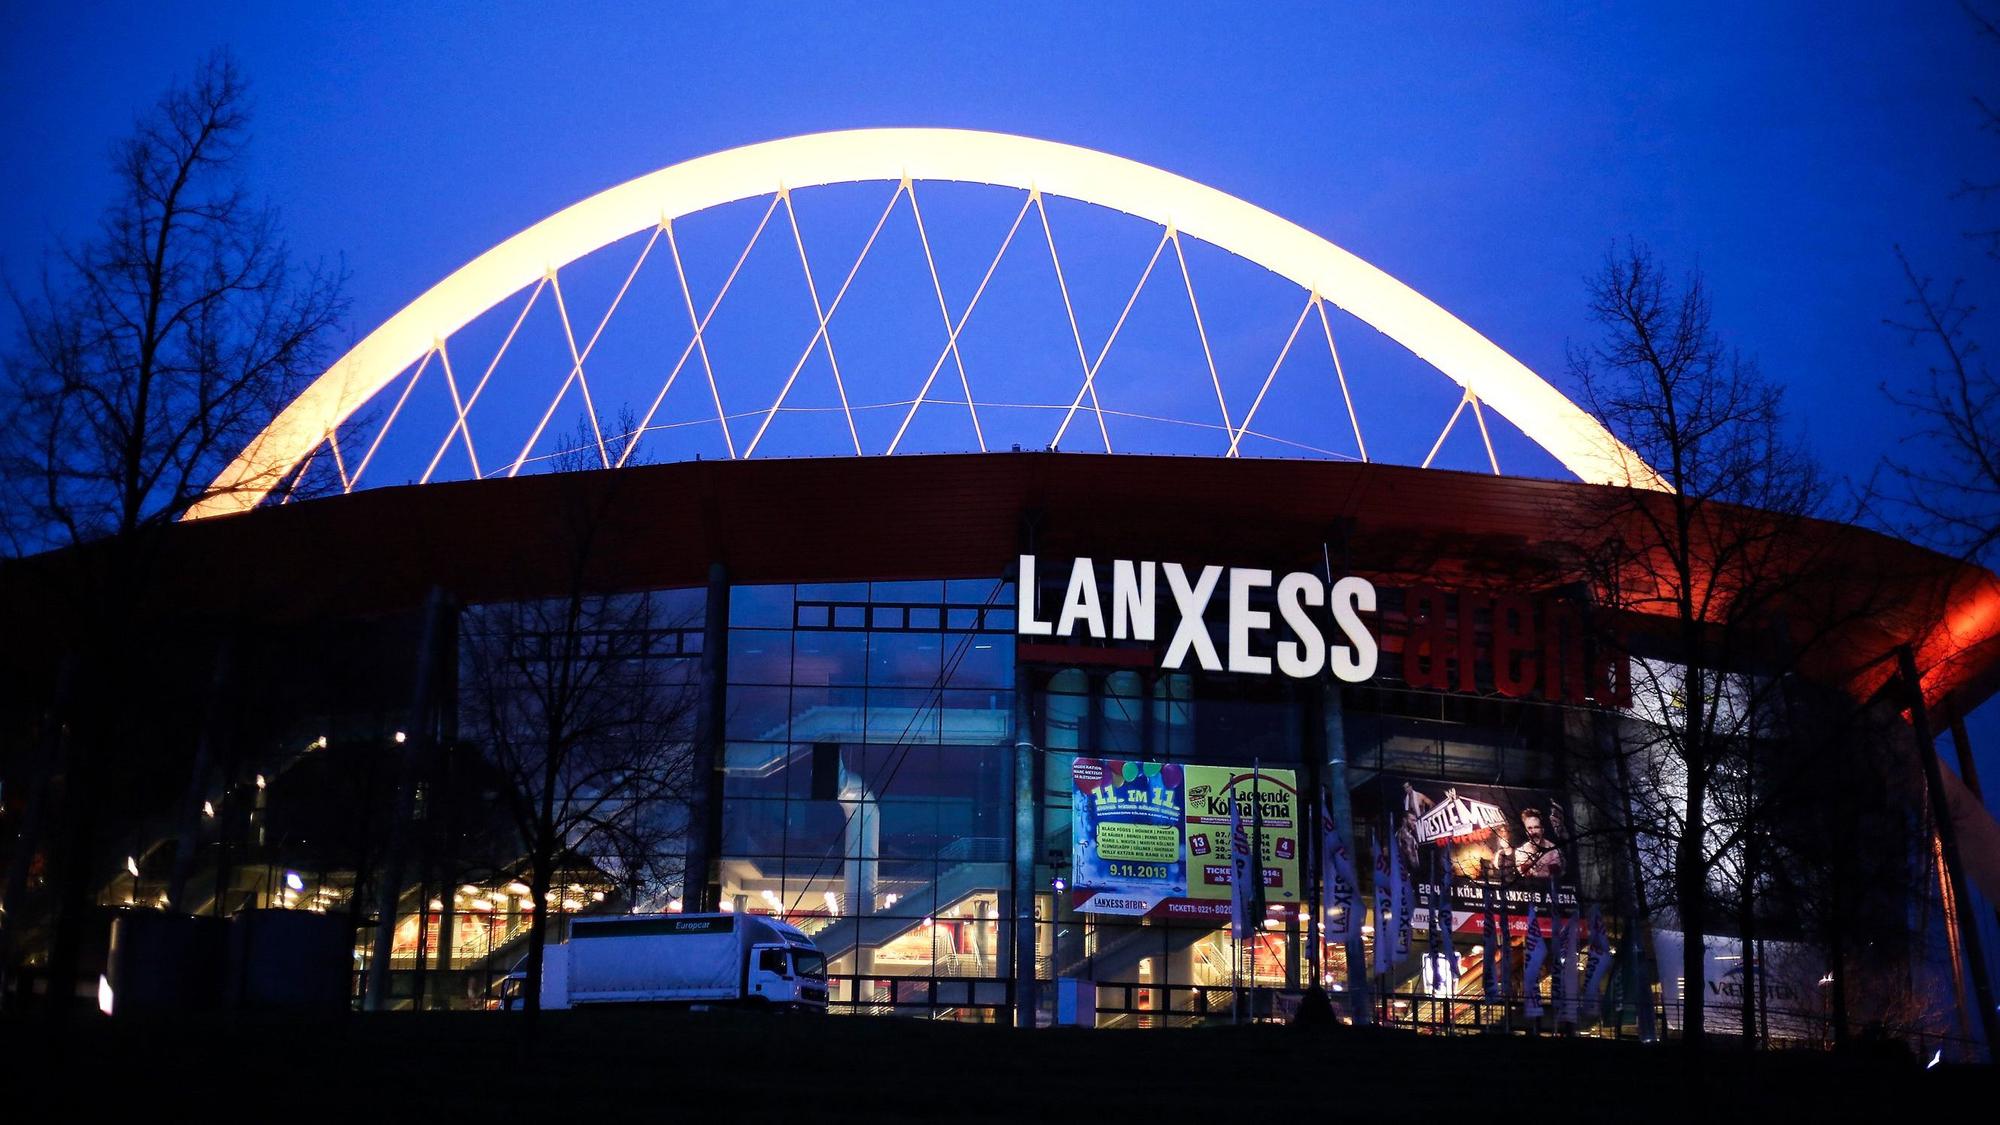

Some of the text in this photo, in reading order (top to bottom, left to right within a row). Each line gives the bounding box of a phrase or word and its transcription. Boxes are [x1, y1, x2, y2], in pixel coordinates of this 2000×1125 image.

[1019, 554, 1378, 682] LANXESS
[1091, 784, 1125, 806] 11.
[1127, 789, 1148, 803] IM
[1152, 787, 1180, 811] 11.
[1192, 836, 1205, 848] 13
[1109, 863, 1167, 878] 9.11.2013
[1457, 884, 1484, 899] KÖLN
[1545, 893, 1578, 904] AENA
[1094, 897, 1124, 909] LANXESS
[675, 921, 711, 931] Europcar
